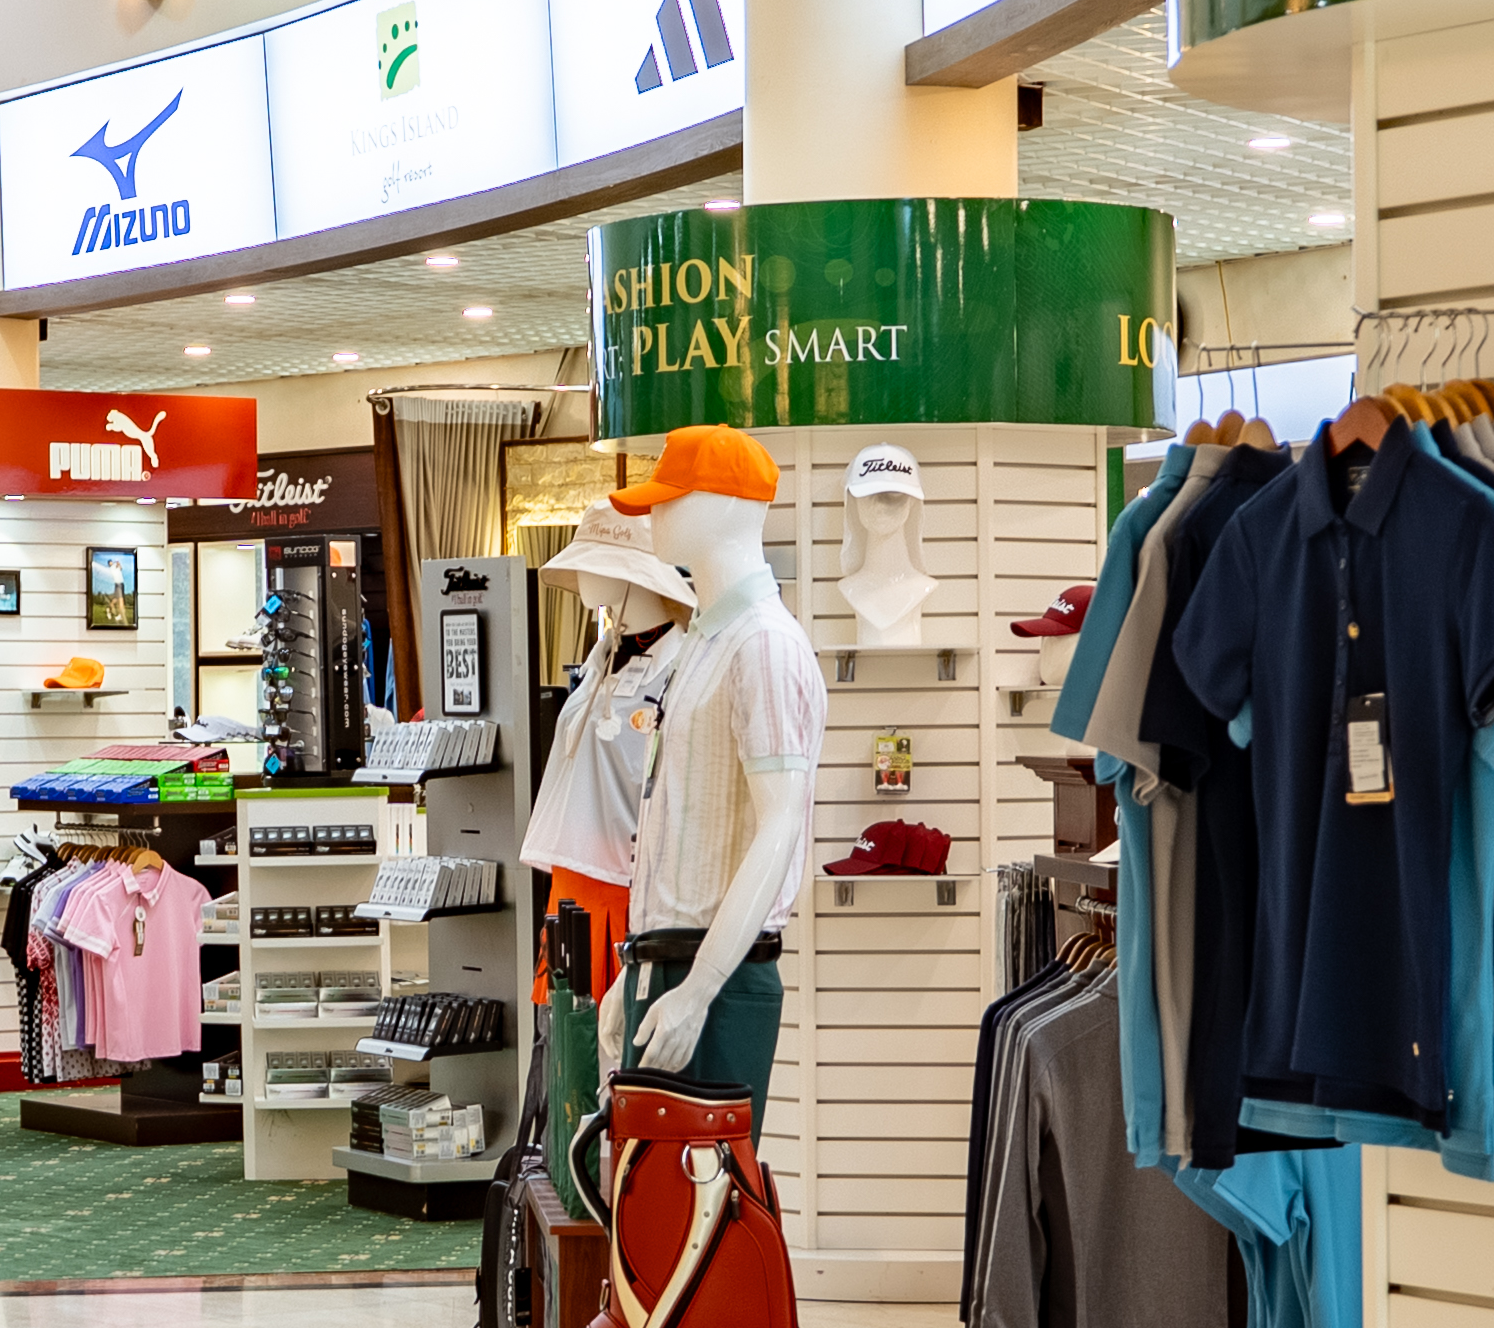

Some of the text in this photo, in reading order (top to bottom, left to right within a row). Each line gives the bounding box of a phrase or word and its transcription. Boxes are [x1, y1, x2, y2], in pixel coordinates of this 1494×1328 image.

[350, 105, 460, 157] KINGS ISLAND
[380, 160, 433, 204] golf resort
[72, 199, 192, 256] MIZUNO
[631, 315, 754, 377] PLAY
[765, 324, 908, 366] SMART
[50, 441, 142, 482] PUMA
[858, 457, 913, 478] Titleist
[446, 648, 477, 679] BEST
